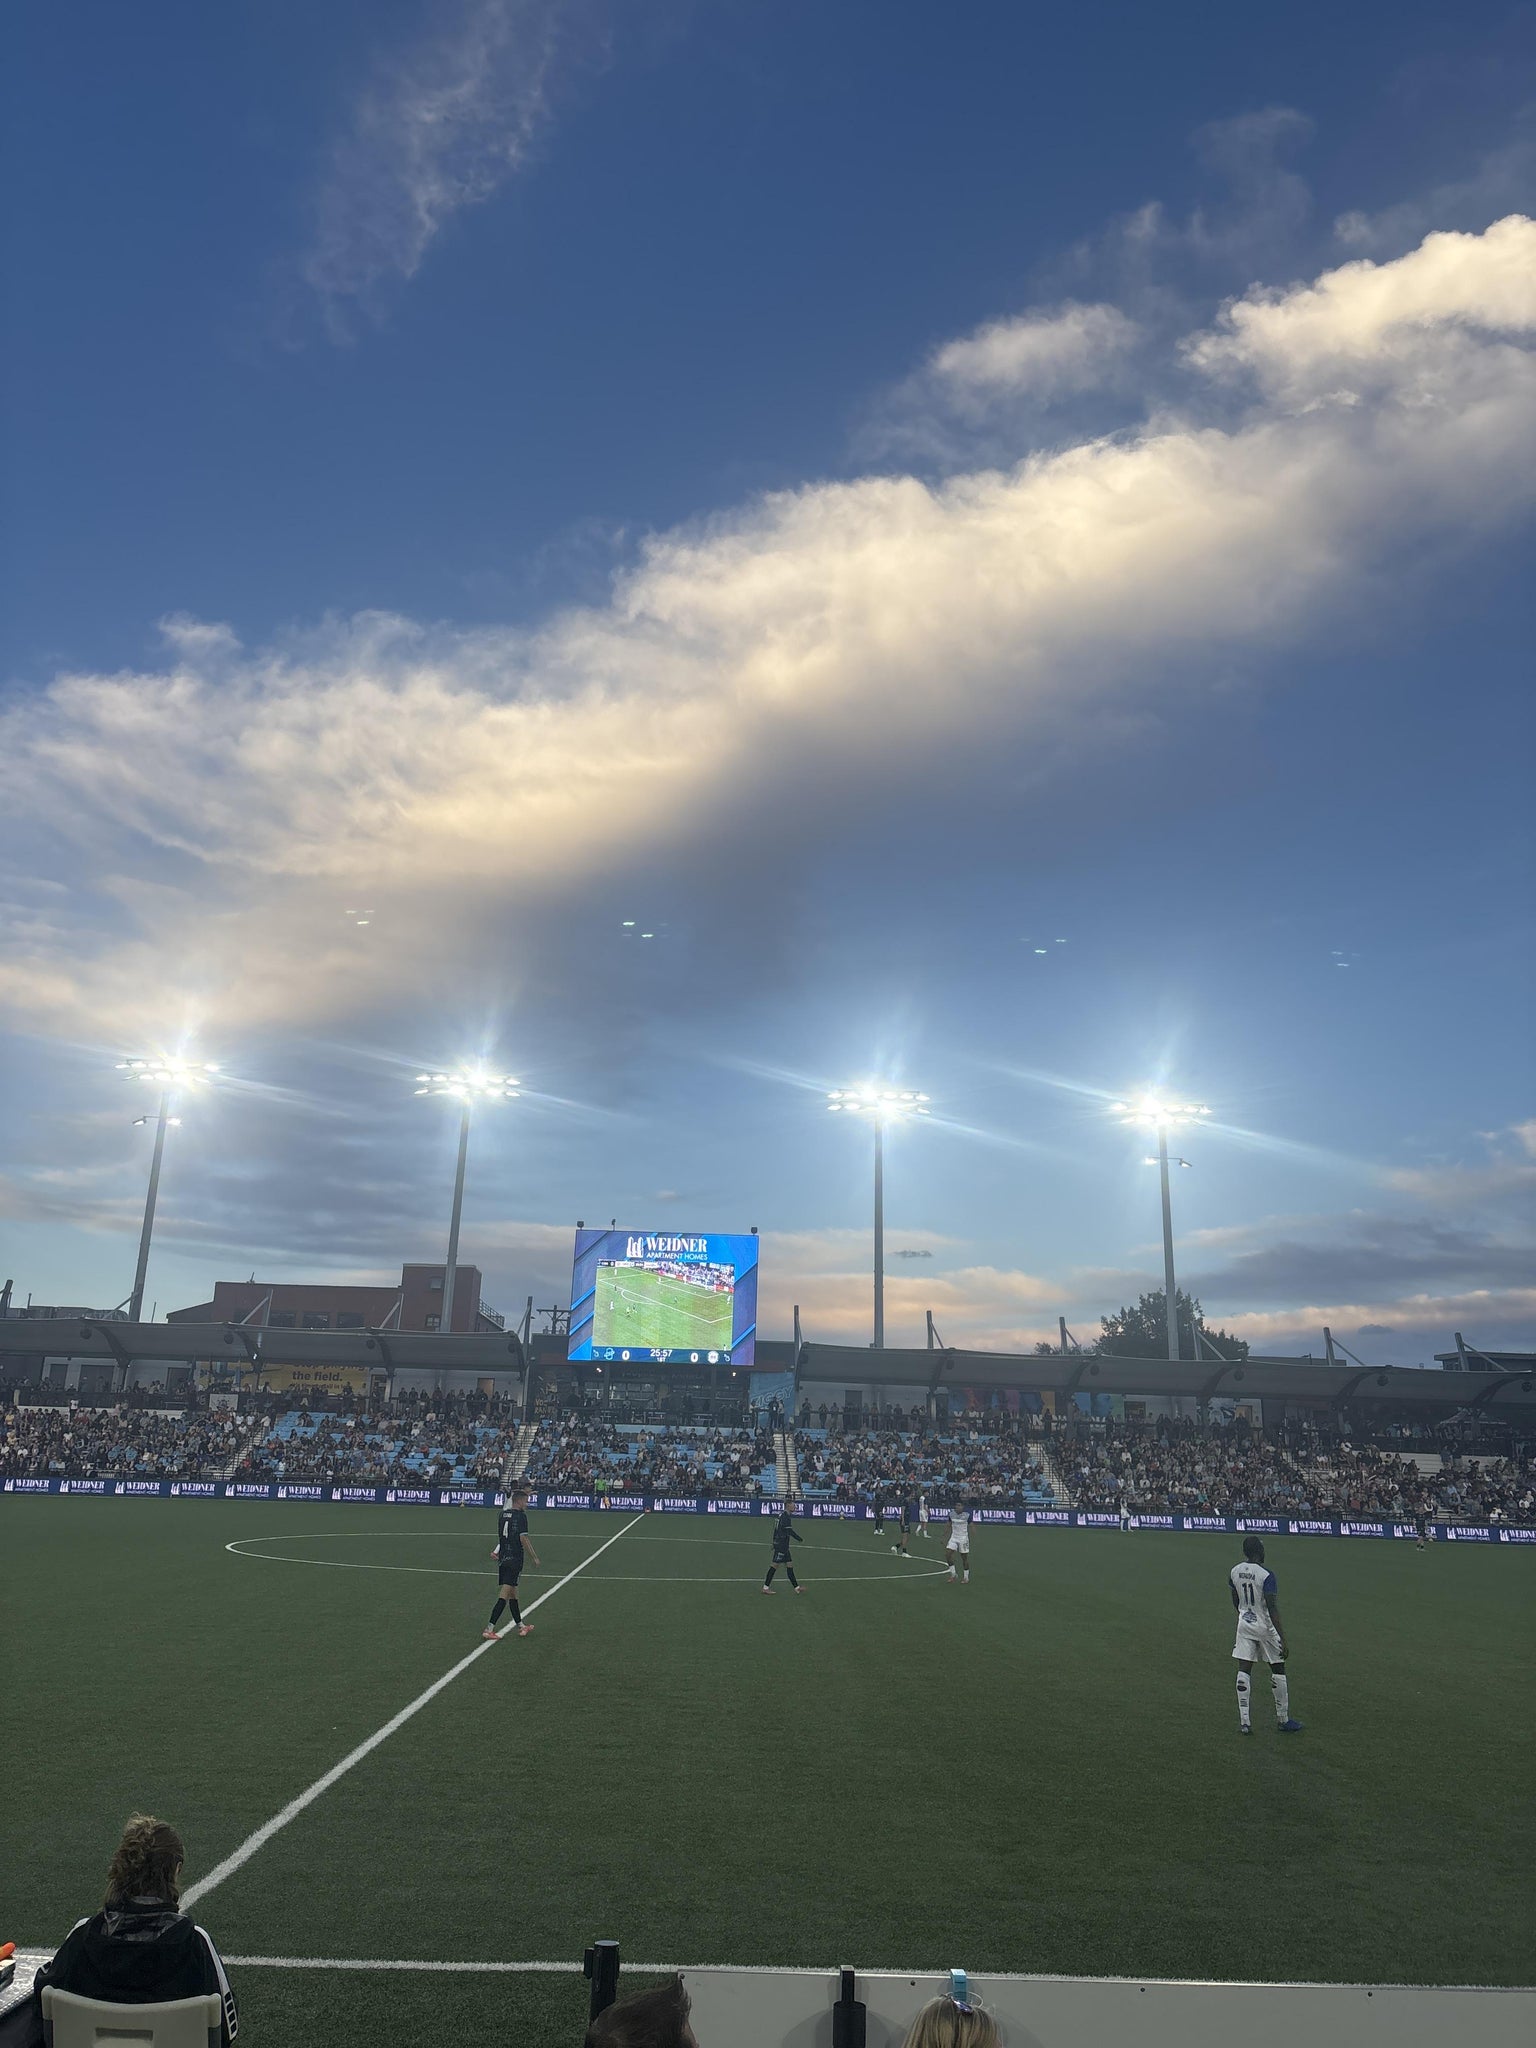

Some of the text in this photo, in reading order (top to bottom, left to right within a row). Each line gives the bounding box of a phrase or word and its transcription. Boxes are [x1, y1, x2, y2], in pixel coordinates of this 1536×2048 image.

[647, 1237, 707, 1252] WEIDNER
[622, 1350, 630, 1360] 0
[650, 1349, 672, 1357] 25:57
[691, 1352, 698, 1362] 0
[292, 1371, 342, 1381] the field.
[16, 1479, 49, 1488] WEIDNER
[71, 1480, 104, 1489] WEIDNER
[126, 1482, 160, 1490] WEIDNER
[182, 1483, 215, 1492] WEIDNER
[237, 1484, 269, 1493] WEIDNER
[289, 1486, 321, 1495] WEIDNER
[343, 1488, 376, 1496] WEIDNER
[397, 1490, 430, 1498] WEIDNER
[452, 1492, 484, 1500] WEIDNER
[557, 1496, 589, 1504] WEIDNER
[611, 1497, 643, 1506] WEIDNER
[665, 1499, 697, 1507] WEIDNER
[718, 1501, 750, 1509] WEIDNER
[983, 1510, 1015, 1518] WEIDNER
[1036, 1512, 1068, 1520] WEIDNER
[1088, 1514, 1120, 1522] WEIDNER
[1140, 1515, 1172, 1524] WEIDNER
[1193, 1517, 1225, 1526] WEIDNER
[1246, 1519, 1278, 1528] WEIDNER
[1299, 1521, 1331, 1530] WEIDNER
[1350, 1523, 1383, 1532] WEIDNER
[1456, 1528, 1489, 1536] WEIDNER
[1242, 1583, 1255, 1606] 11
